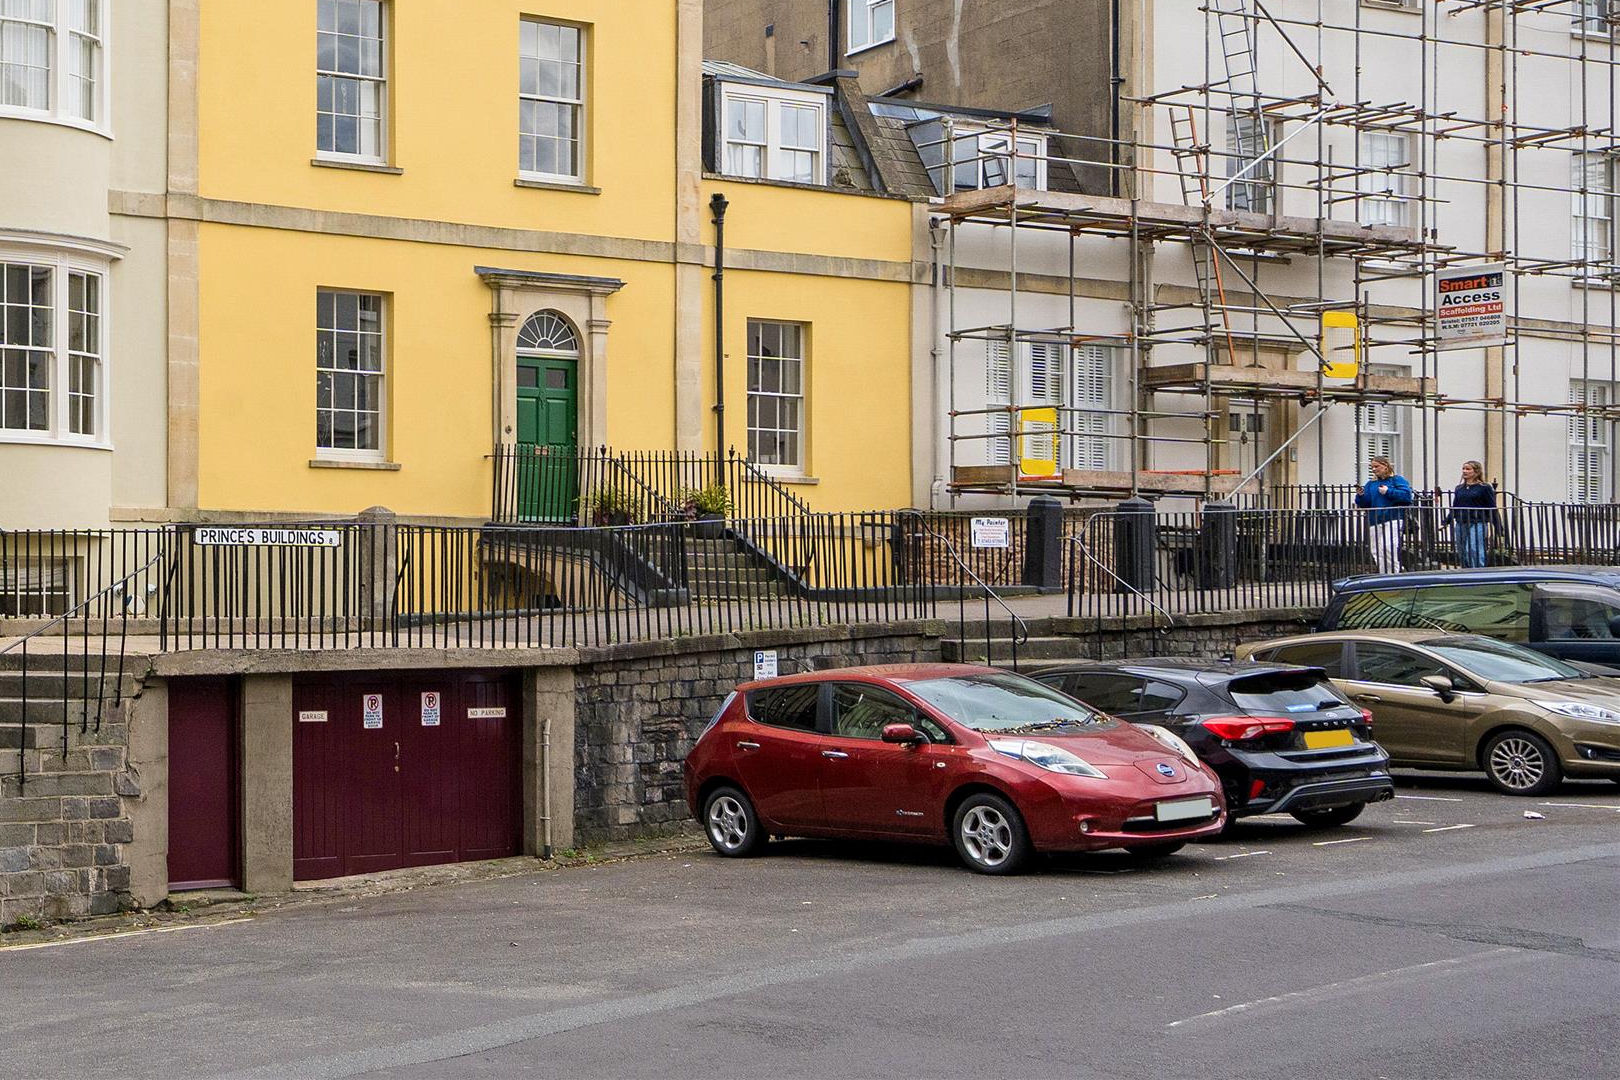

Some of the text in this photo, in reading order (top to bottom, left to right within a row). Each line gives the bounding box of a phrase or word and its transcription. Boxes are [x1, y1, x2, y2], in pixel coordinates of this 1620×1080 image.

[1440, 276, 1488, 292] Smart
[1442, 292, 1500, 305] Access
[1440, 306, 1486, 316] Scaffolding
[201, 529, 254, 543] PRINCE'S
[262, 530, 324, 544] BUILDINGS
